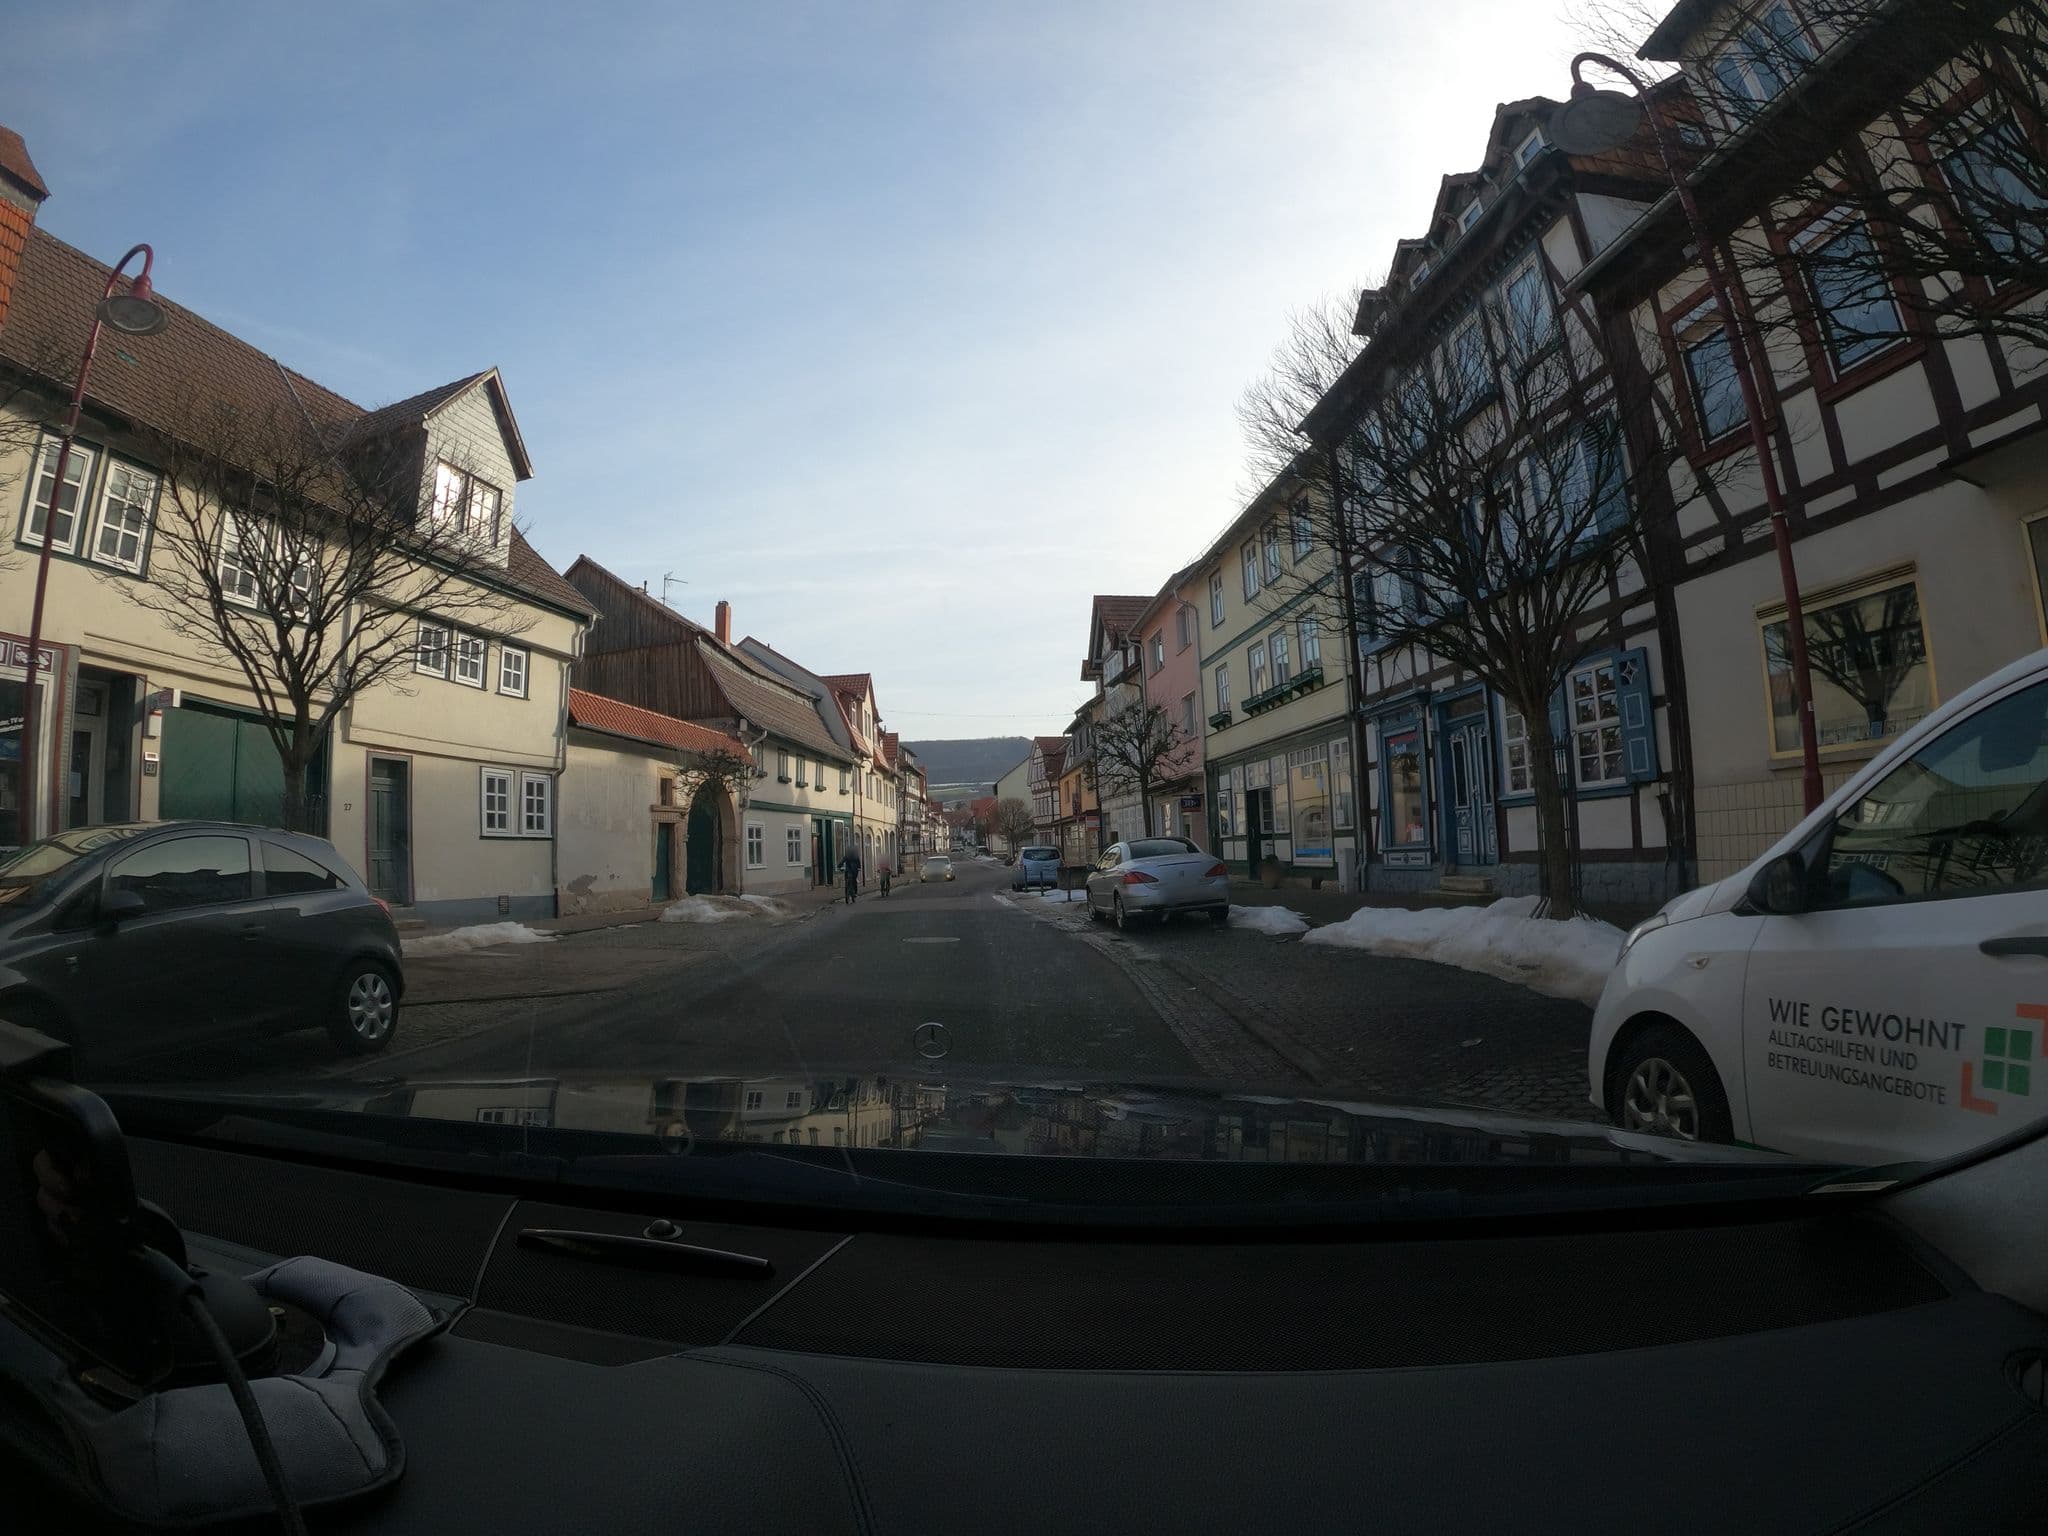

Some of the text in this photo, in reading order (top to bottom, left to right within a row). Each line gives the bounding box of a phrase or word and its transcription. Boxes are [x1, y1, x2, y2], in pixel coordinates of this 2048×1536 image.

[1768, 1029, 1918, 1071] ALLTAGSHILFEN UND
[1769, 998, 1966, 1051] WIE GEWOHNT
[1768, 1052, 1947, 1105] BETREUUNGSANGEBOTE
